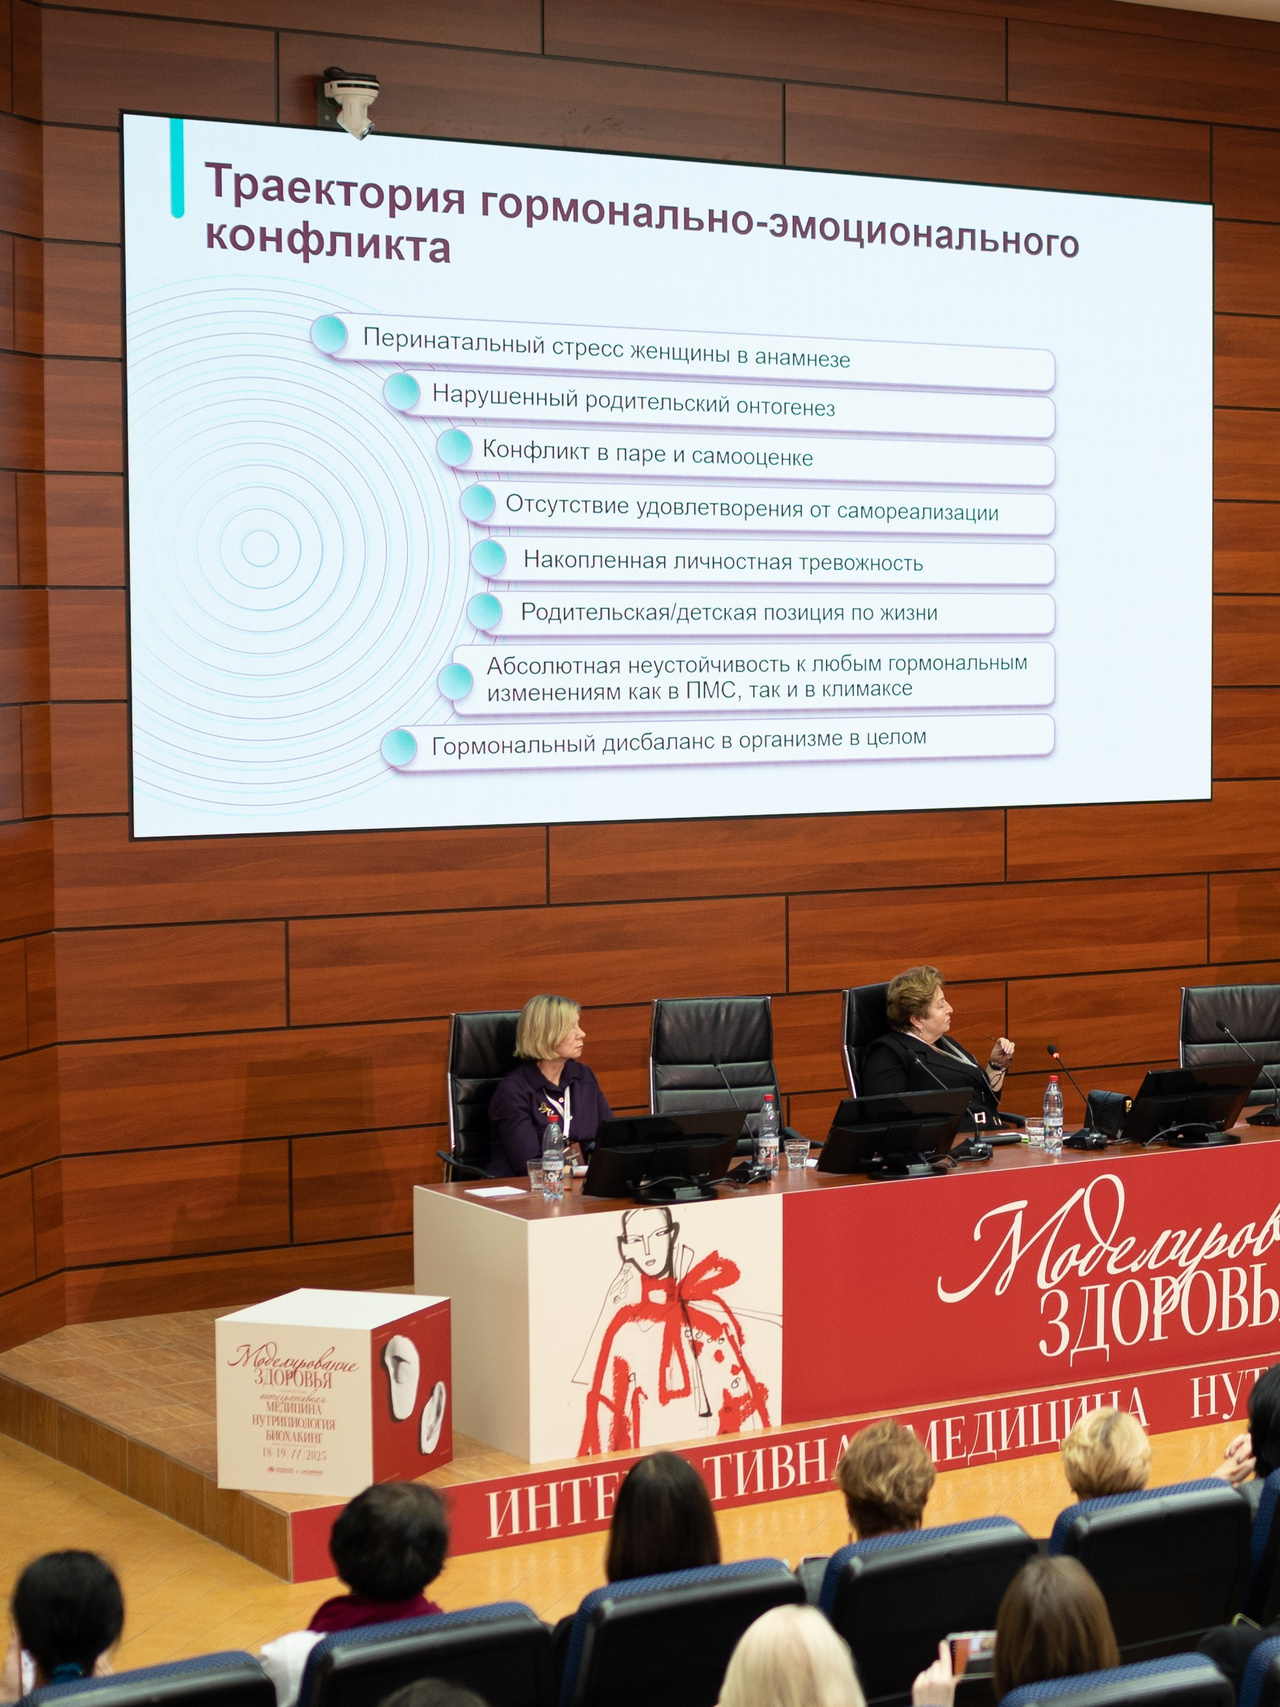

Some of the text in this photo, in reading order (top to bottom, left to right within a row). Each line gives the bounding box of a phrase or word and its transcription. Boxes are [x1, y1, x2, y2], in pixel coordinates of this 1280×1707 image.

[203, 160, 1080, 258] Траектория гормонально-эмоционального
[206, 219, 452, 263] конфликта
[363, 326, 851, 368] Перинатальный стресс женщины в анамнезе
[433, 382, 836, 416] Нарушенный родительский онтогенез
[483, 438, 814, 468] Конфликт в паре и самооценке
[505, 493, 999, 524] Отсутствие удовлетворения от самореализации
[524, 548, 924, 575] Накопленная личностная тревожность
[521, 601, 938, 624] Родительская/детская позиция по жизни
[486, 653, 1028, 679] Абсолютная неустойчивость к любым гормональным
[487, 680, 913, 702] изменениям как в ПМС, так и в климаксе
[432, 731, 927, 760] Гормональный дисбаланс в организме в целом
[227, 1341, 360, 1380] Моделирование
[254, 1367, 332, 1389] ЗДОРОВЬЯ
[252, 1414, 336, 1430] НУТРИЦИОЛОГИЯ
[266, 1401, 322, 1415] МЕДИЦИНА
[265, 1430, 323, 1444] БИОХАКИНГ
